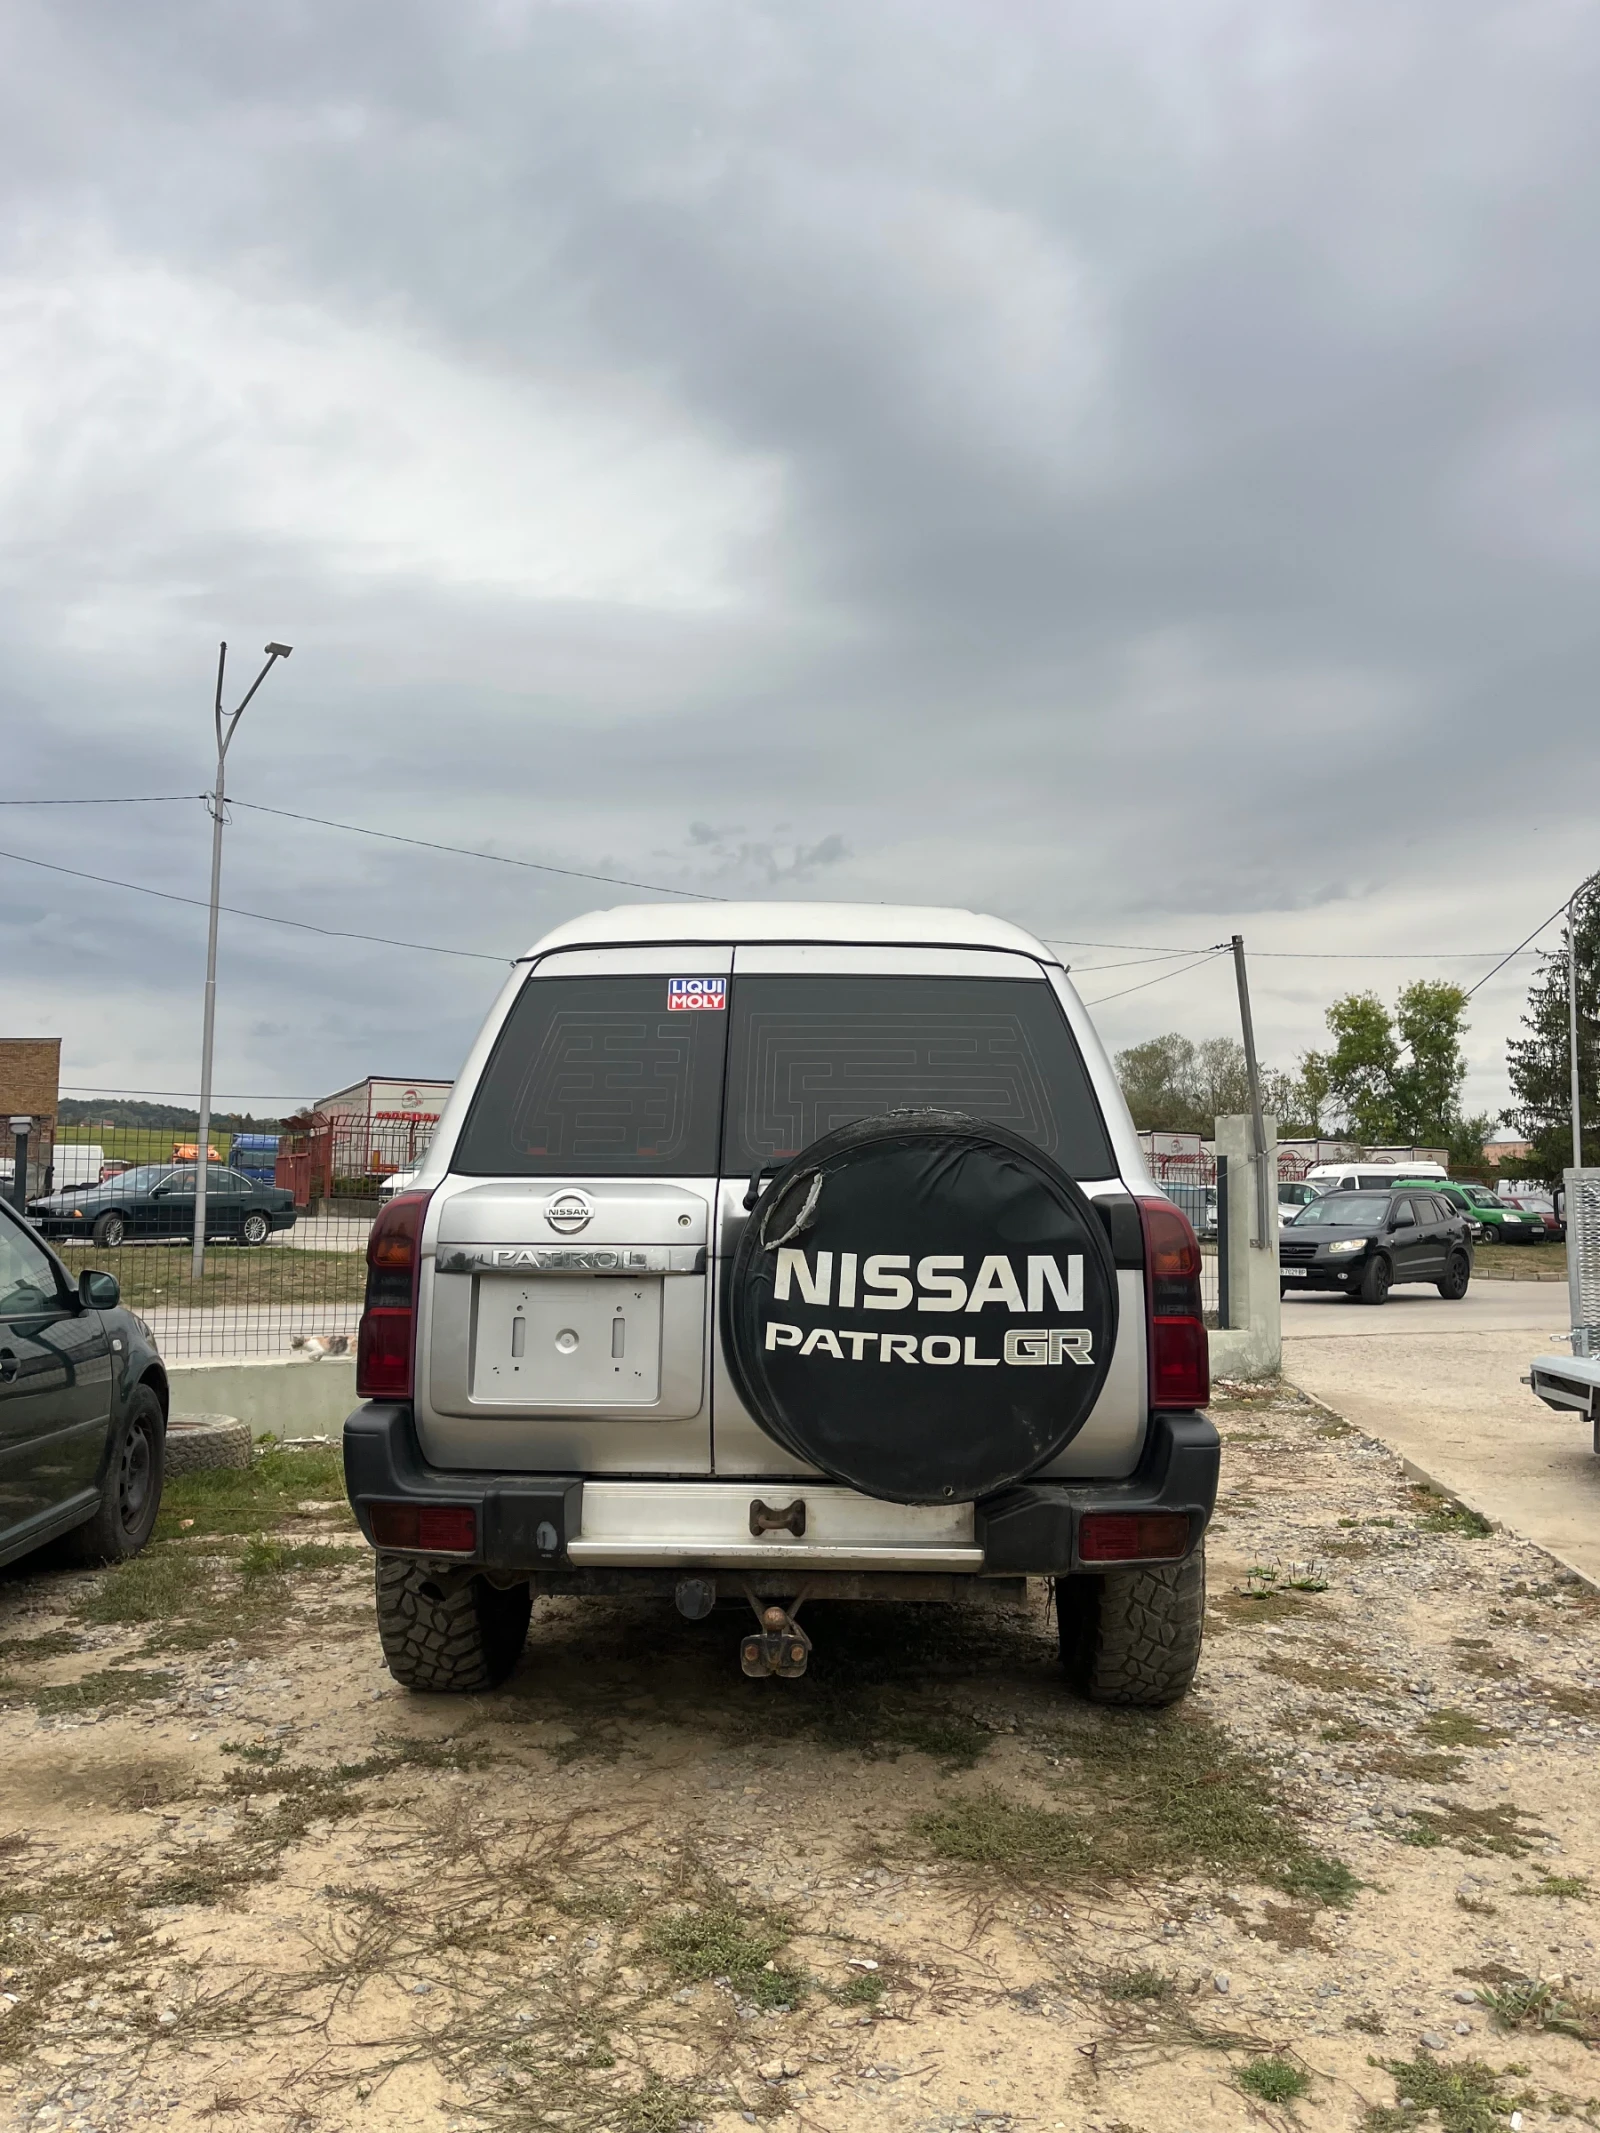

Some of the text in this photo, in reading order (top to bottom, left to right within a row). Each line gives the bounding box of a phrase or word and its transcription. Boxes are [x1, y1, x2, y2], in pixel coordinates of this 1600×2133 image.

[672, 980, 723, 994] LIQUI
[671, 994, 724, 1008] MOLY
[548, 1208, 589, 1216] NISSAN
[491, 1250, 646, 1269] PATROL
[773, 1247, 1085, 1313] NISSAN
[764, 1321, 1096, 1366] PATROL GR
